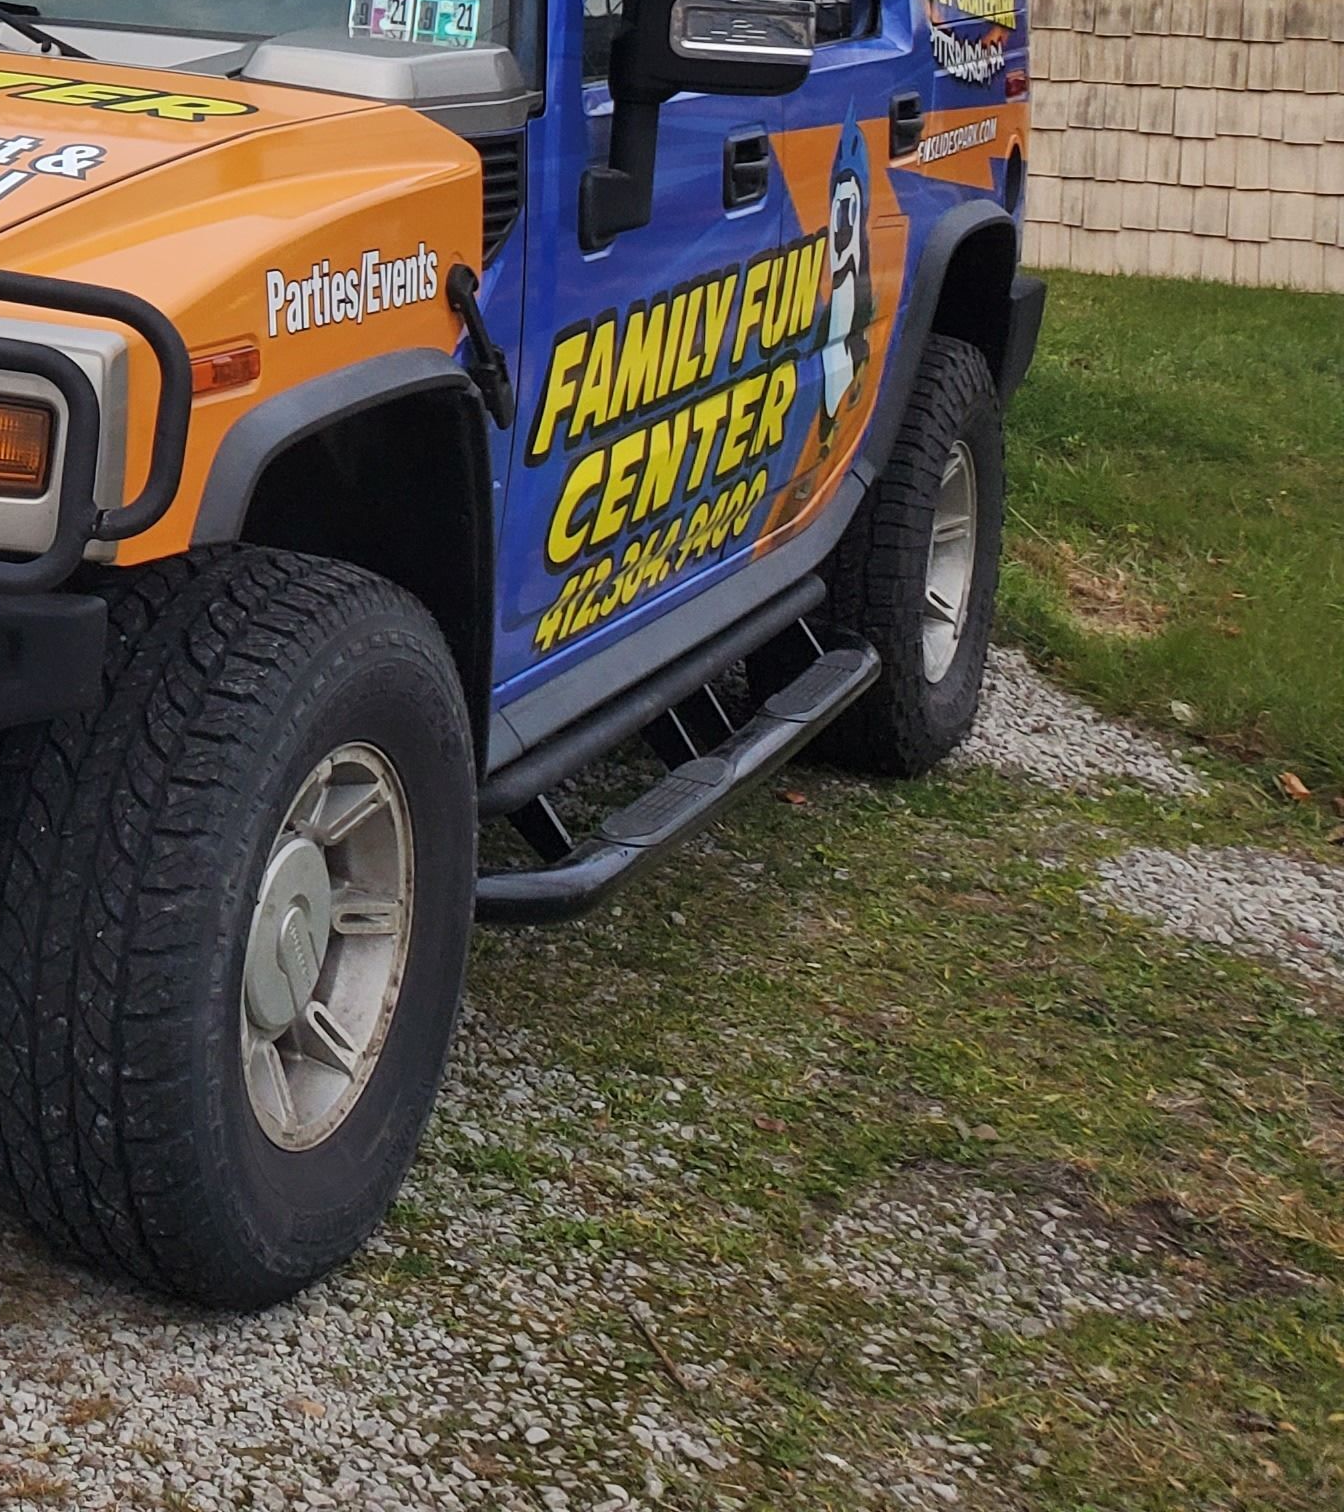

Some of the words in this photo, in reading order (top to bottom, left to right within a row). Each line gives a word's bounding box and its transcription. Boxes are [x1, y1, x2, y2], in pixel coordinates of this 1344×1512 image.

[456, 3, 473, 32] 21
[29, 143, 108, 179] &
[528, 270, 739, 460] FAMILY
[729, 233, 829, 365] FUN
[546, 359, 798, 566] CENTER
